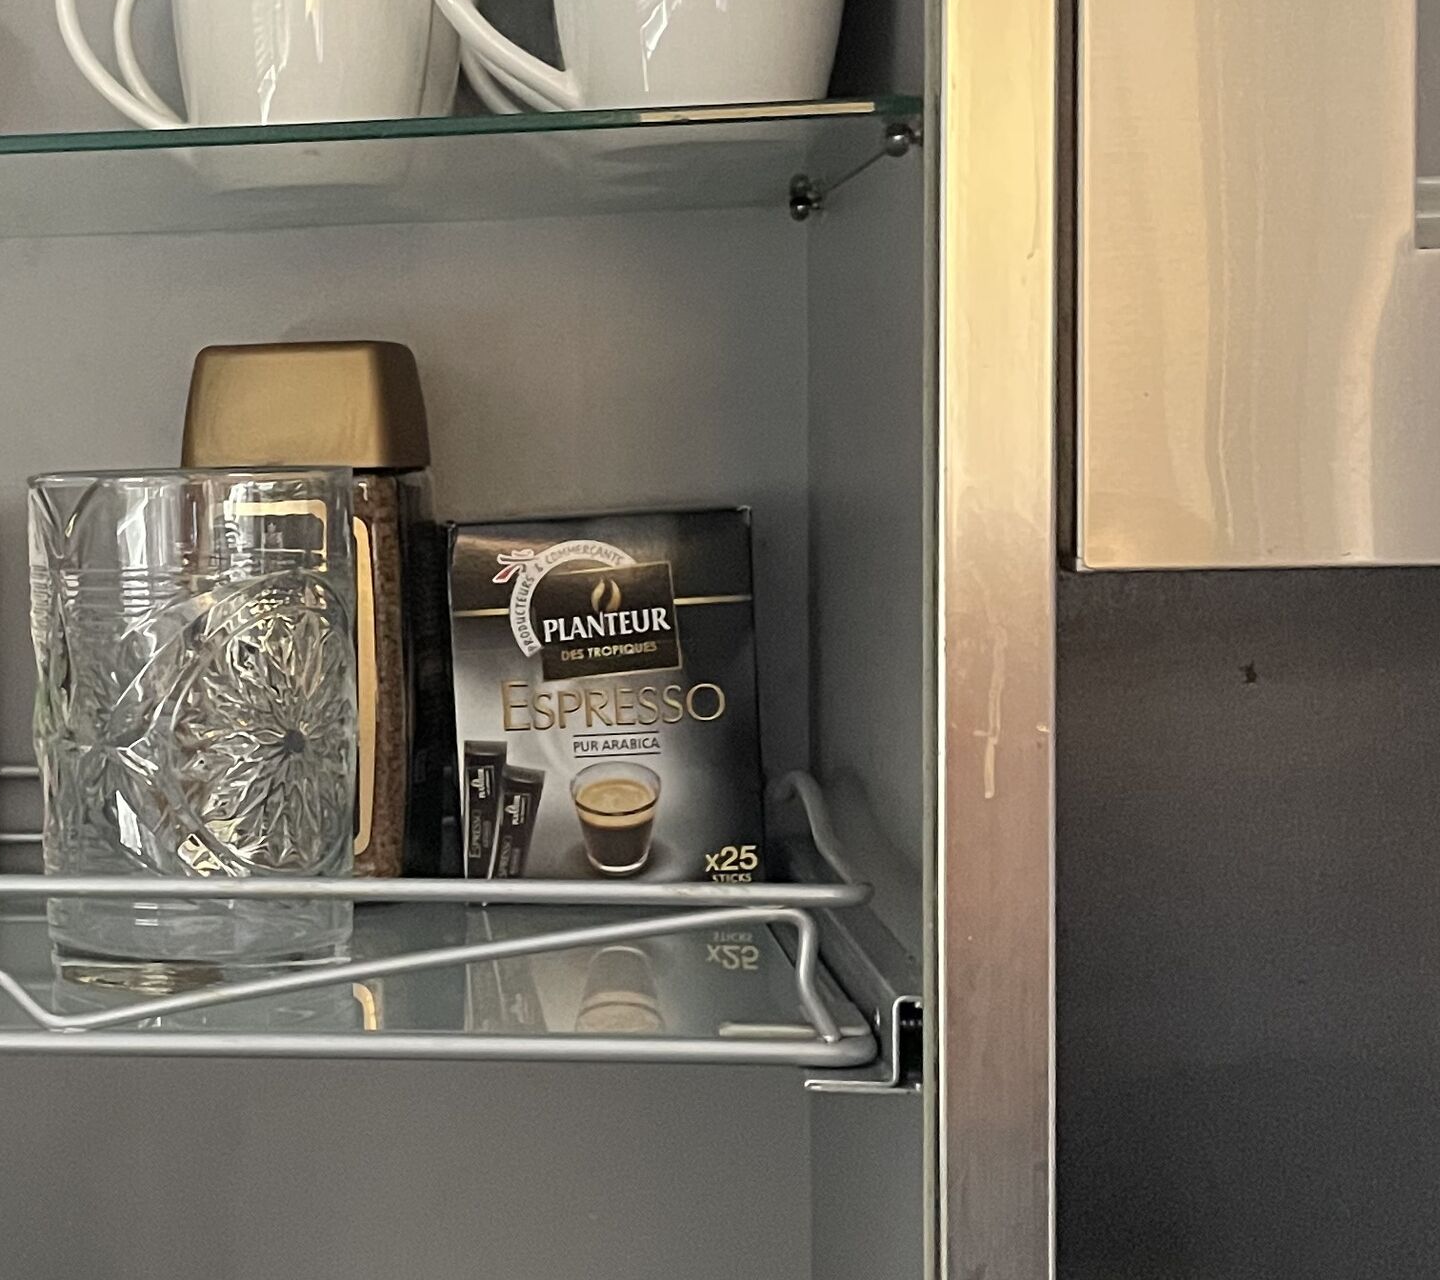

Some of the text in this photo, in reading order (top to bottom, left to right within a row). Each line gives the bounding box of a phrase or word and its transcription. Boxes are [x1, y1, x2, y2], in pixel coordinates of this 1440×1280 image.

[517, 575, 537, 654] PRODUCTEURS
[543, 607, 672, 643] PLANTEUR
[561, 641, 658, 661] DES TROPIQUES
[501, 680, 726, 731] ESPRESSO
[573, 737, 660, 754] PUR ARABICA
[705, 845, 758, 872] x25
[712, 873, 752, 883] STICKS
